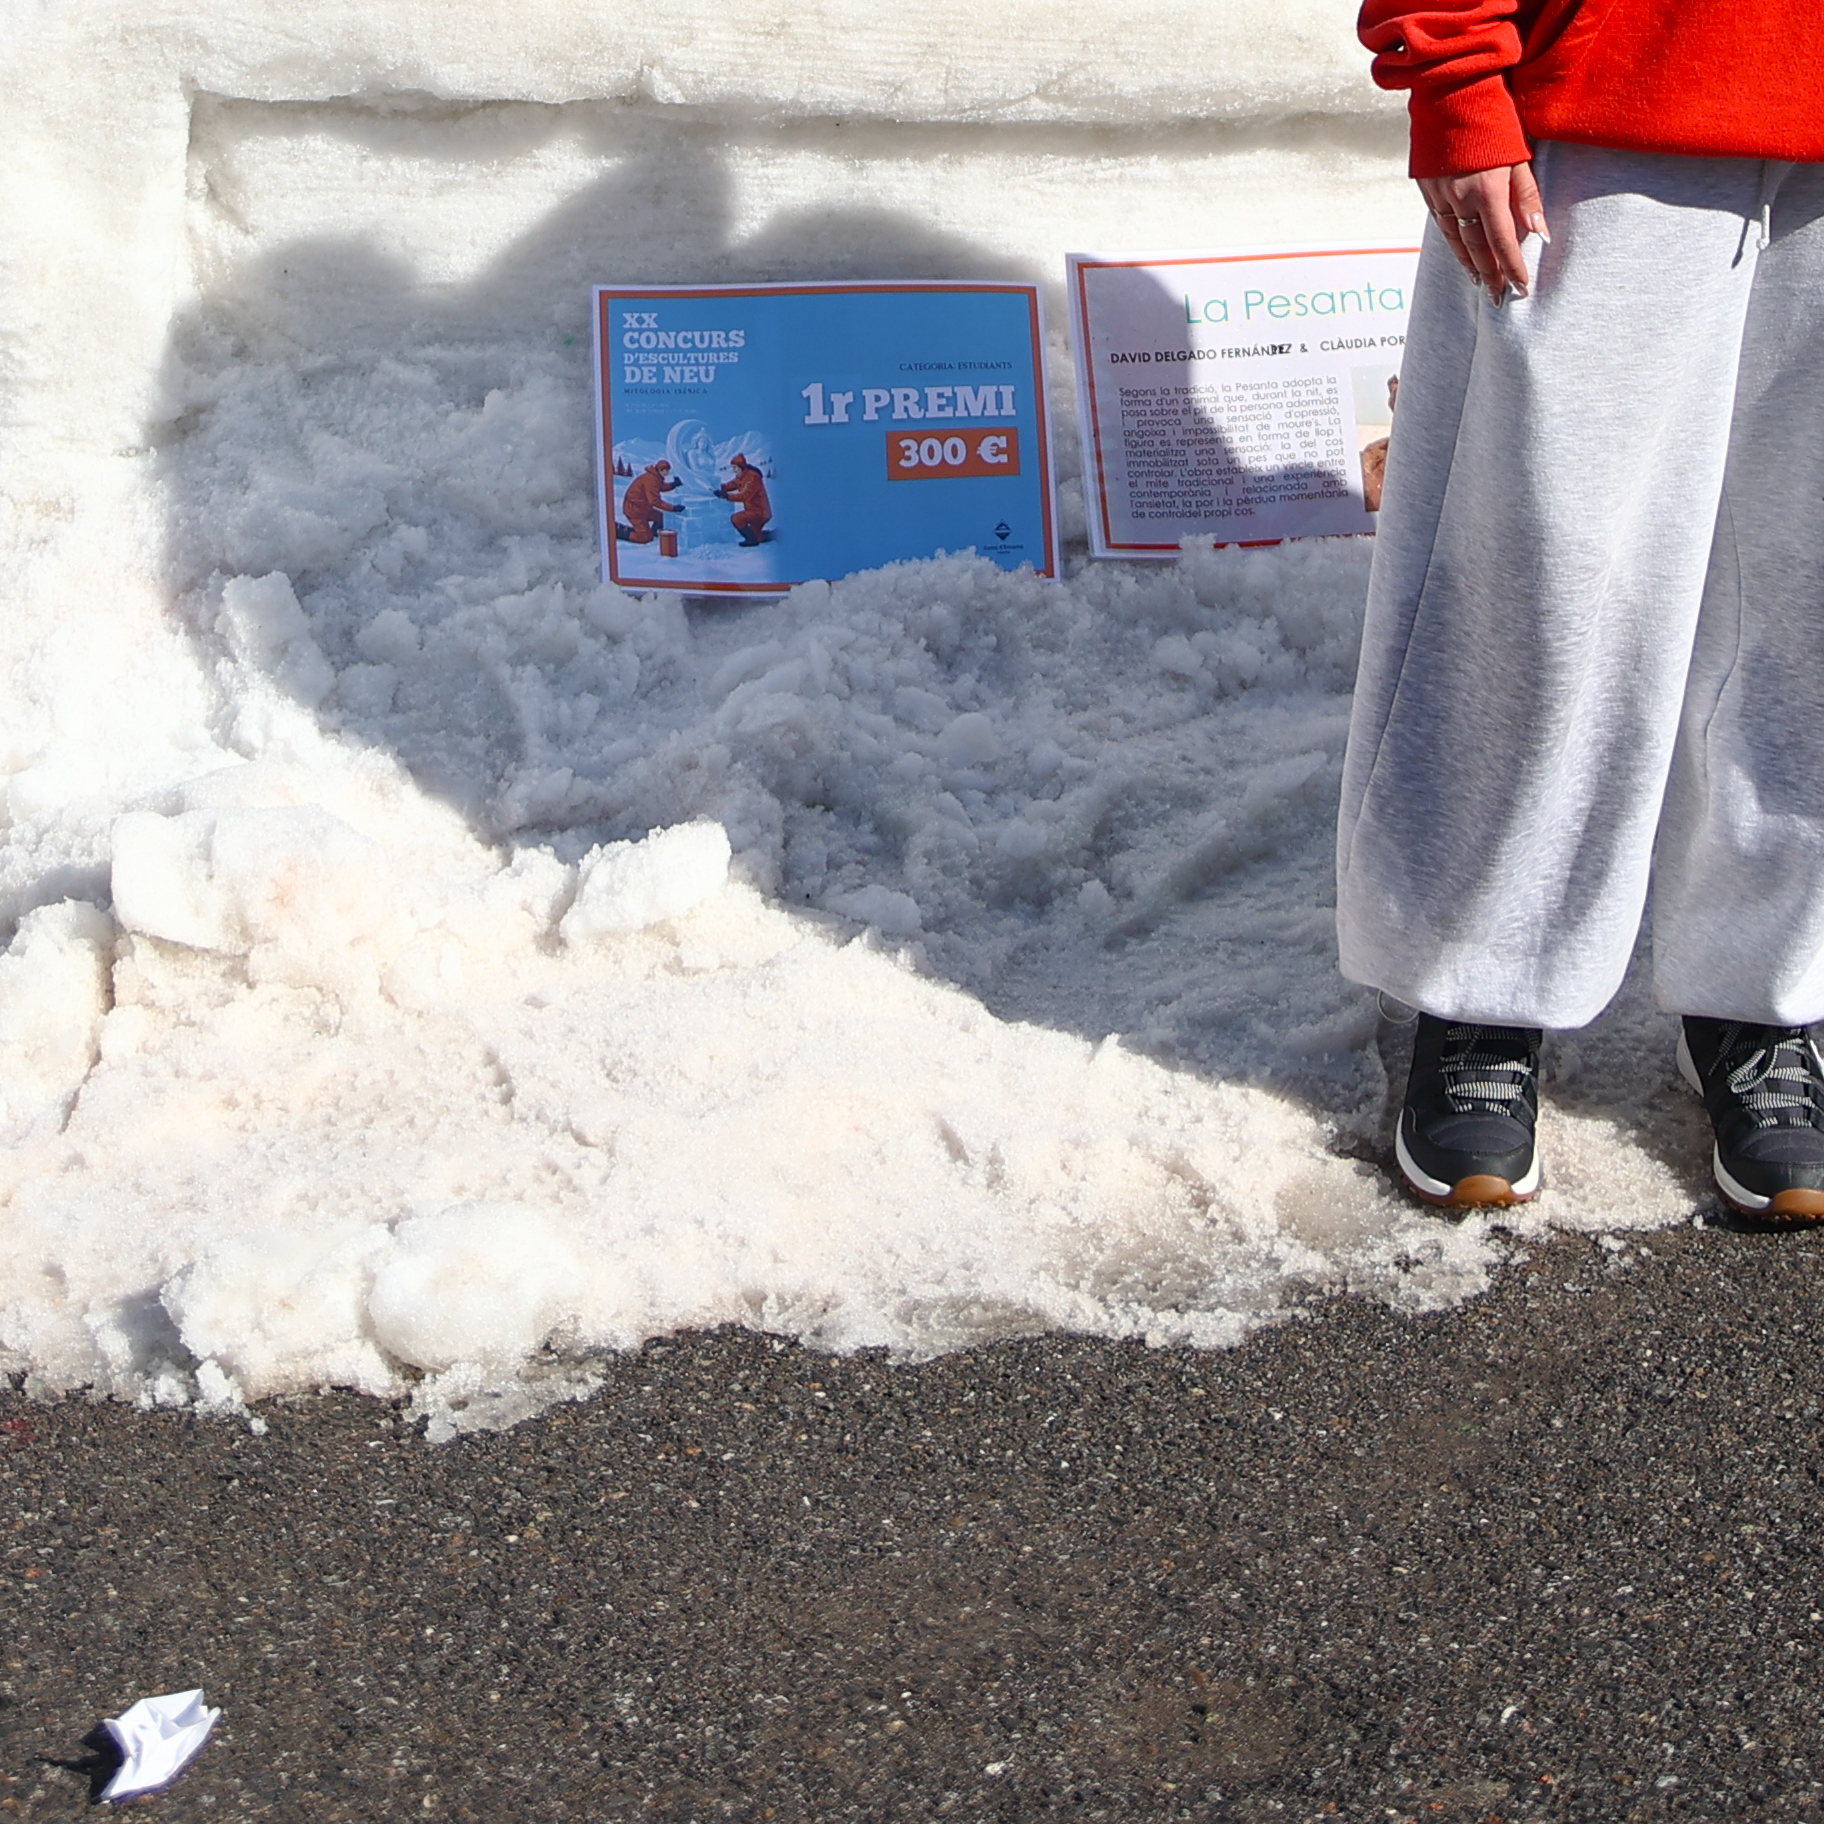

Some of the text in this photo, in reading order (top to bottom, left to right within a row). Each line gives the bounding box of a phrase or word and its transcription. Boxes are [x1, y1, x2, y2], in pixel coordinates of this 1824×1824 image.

[1184, 281, 1405, 325] La Pesanta
[623, 312, 659, 329] XX
[623, 329, 746, 349] CONCURS
[623, 351, 739, 365] D'ESCULTURES
[1110, 351, 1152, 364] DAVID
[1154, 349, 1217, 363] DELGADO
[1299, 343, 1309, 353] &
[1320, 336, 1377, 352] CLÀUDIA
[1380, 335, 1408, 347] POR
[624, 365, 716, 384] DE NEU
[898, 361, 1013, 372] CATEGORIA: ESTUDIANTS
[1119, 387, 1157, 398] Segons
[1175, 384, 1217, 396] tradició,
[1236, 381, 1278, 392] Pesanta
[1282, 377, 1323, 388] adopta
[1252, 390, 1288, 400] durant
[800, 382, 1017, 425] 1r PREMI
[1121, 409, 1147, 418] posa
[1150, 407, 1179, 416] sobre
[1240, 402, 1283, 414] persona
[1286, 396, 1339, 408] adormida
[1136, 418, 1182, 428] provoca
[1226, 411, 1272, 422] sensació
[1284, 406, 1340, 418] d'opressió,
[1122, 428, 1166, 438] angoixa
[1182, 424, 1249, 436] impossibilitat
[1176, 436, 1234, 447] representa
[1258, 432, 1290, 442] forma
[897, 434, 1009, 468] 300 €
[1124, 448, 1186, 458] materialitza
[1224, 444, 1273, 455] sensació:
[1126, 458, 1189, 468] immobilitzat
[1127, 469, 1178, 478] controlar.
[1180, 468, 1214, 476] L'obra
[1216, 465, 1263, 475] estableix
[1178, 476, 1234, 487] tradicional
[1283, 468, 1346, 482] experiència
[1129, 488, 1212, 500] contemporània
[1242, 481, 1308, 494] relacionada
[1236, 494, 1276, 507] pèrdua
[1280, 488, 1349, 502] momentània
